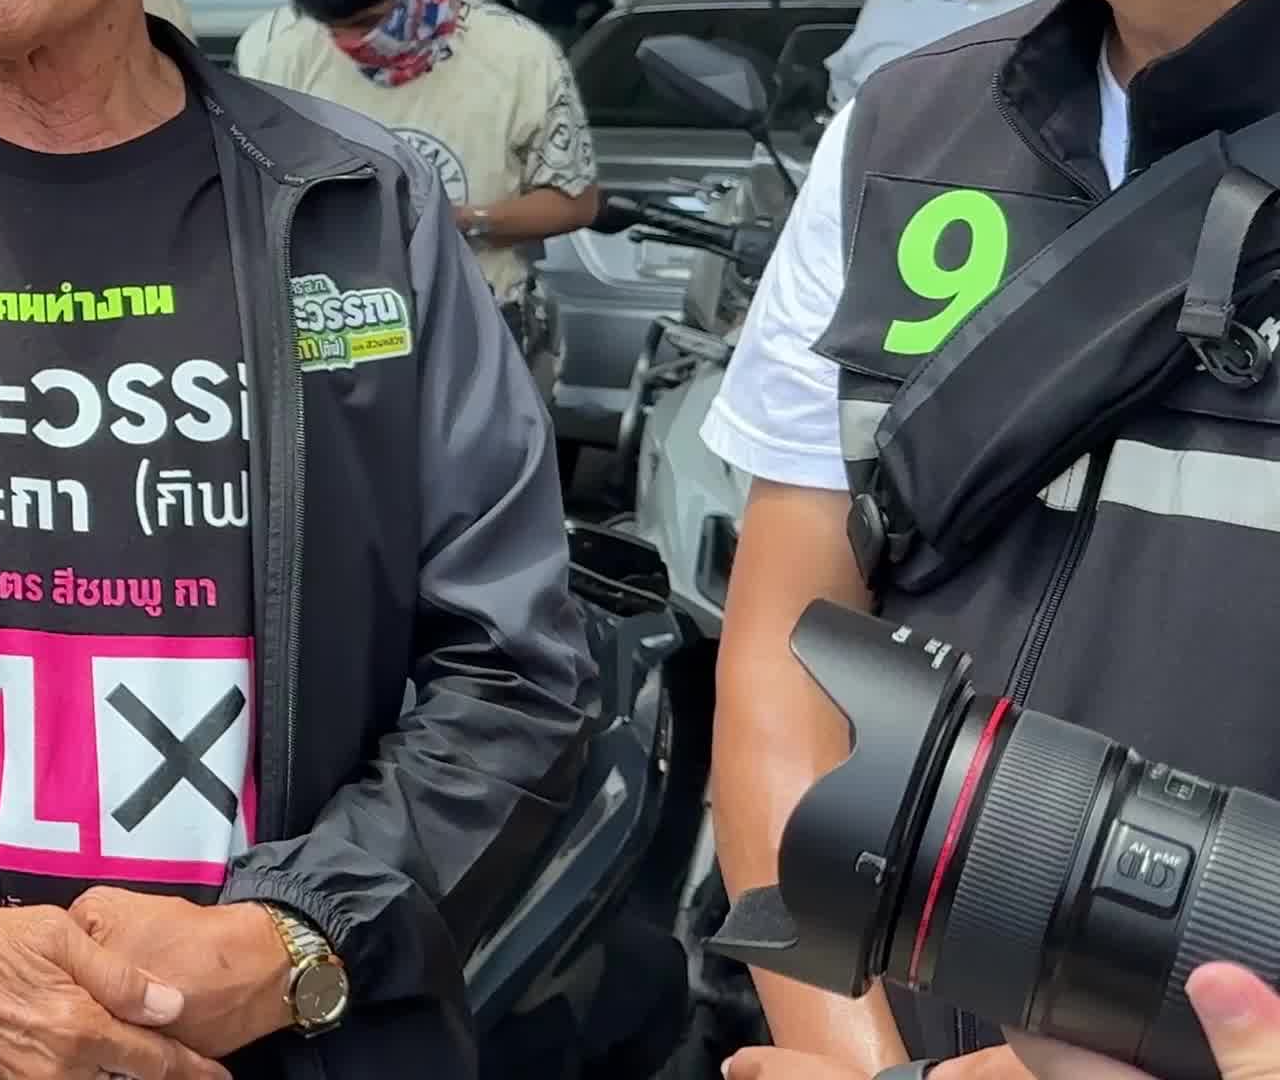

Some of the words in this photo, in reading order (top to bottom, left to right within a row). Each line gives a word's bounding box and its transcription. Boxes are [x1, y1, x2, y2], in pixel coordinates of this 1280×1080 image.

[883, 189, 1009, 356] 9
[52, 567, 163, 617] สีชมพู
[174, 577, 218, 608] กา
